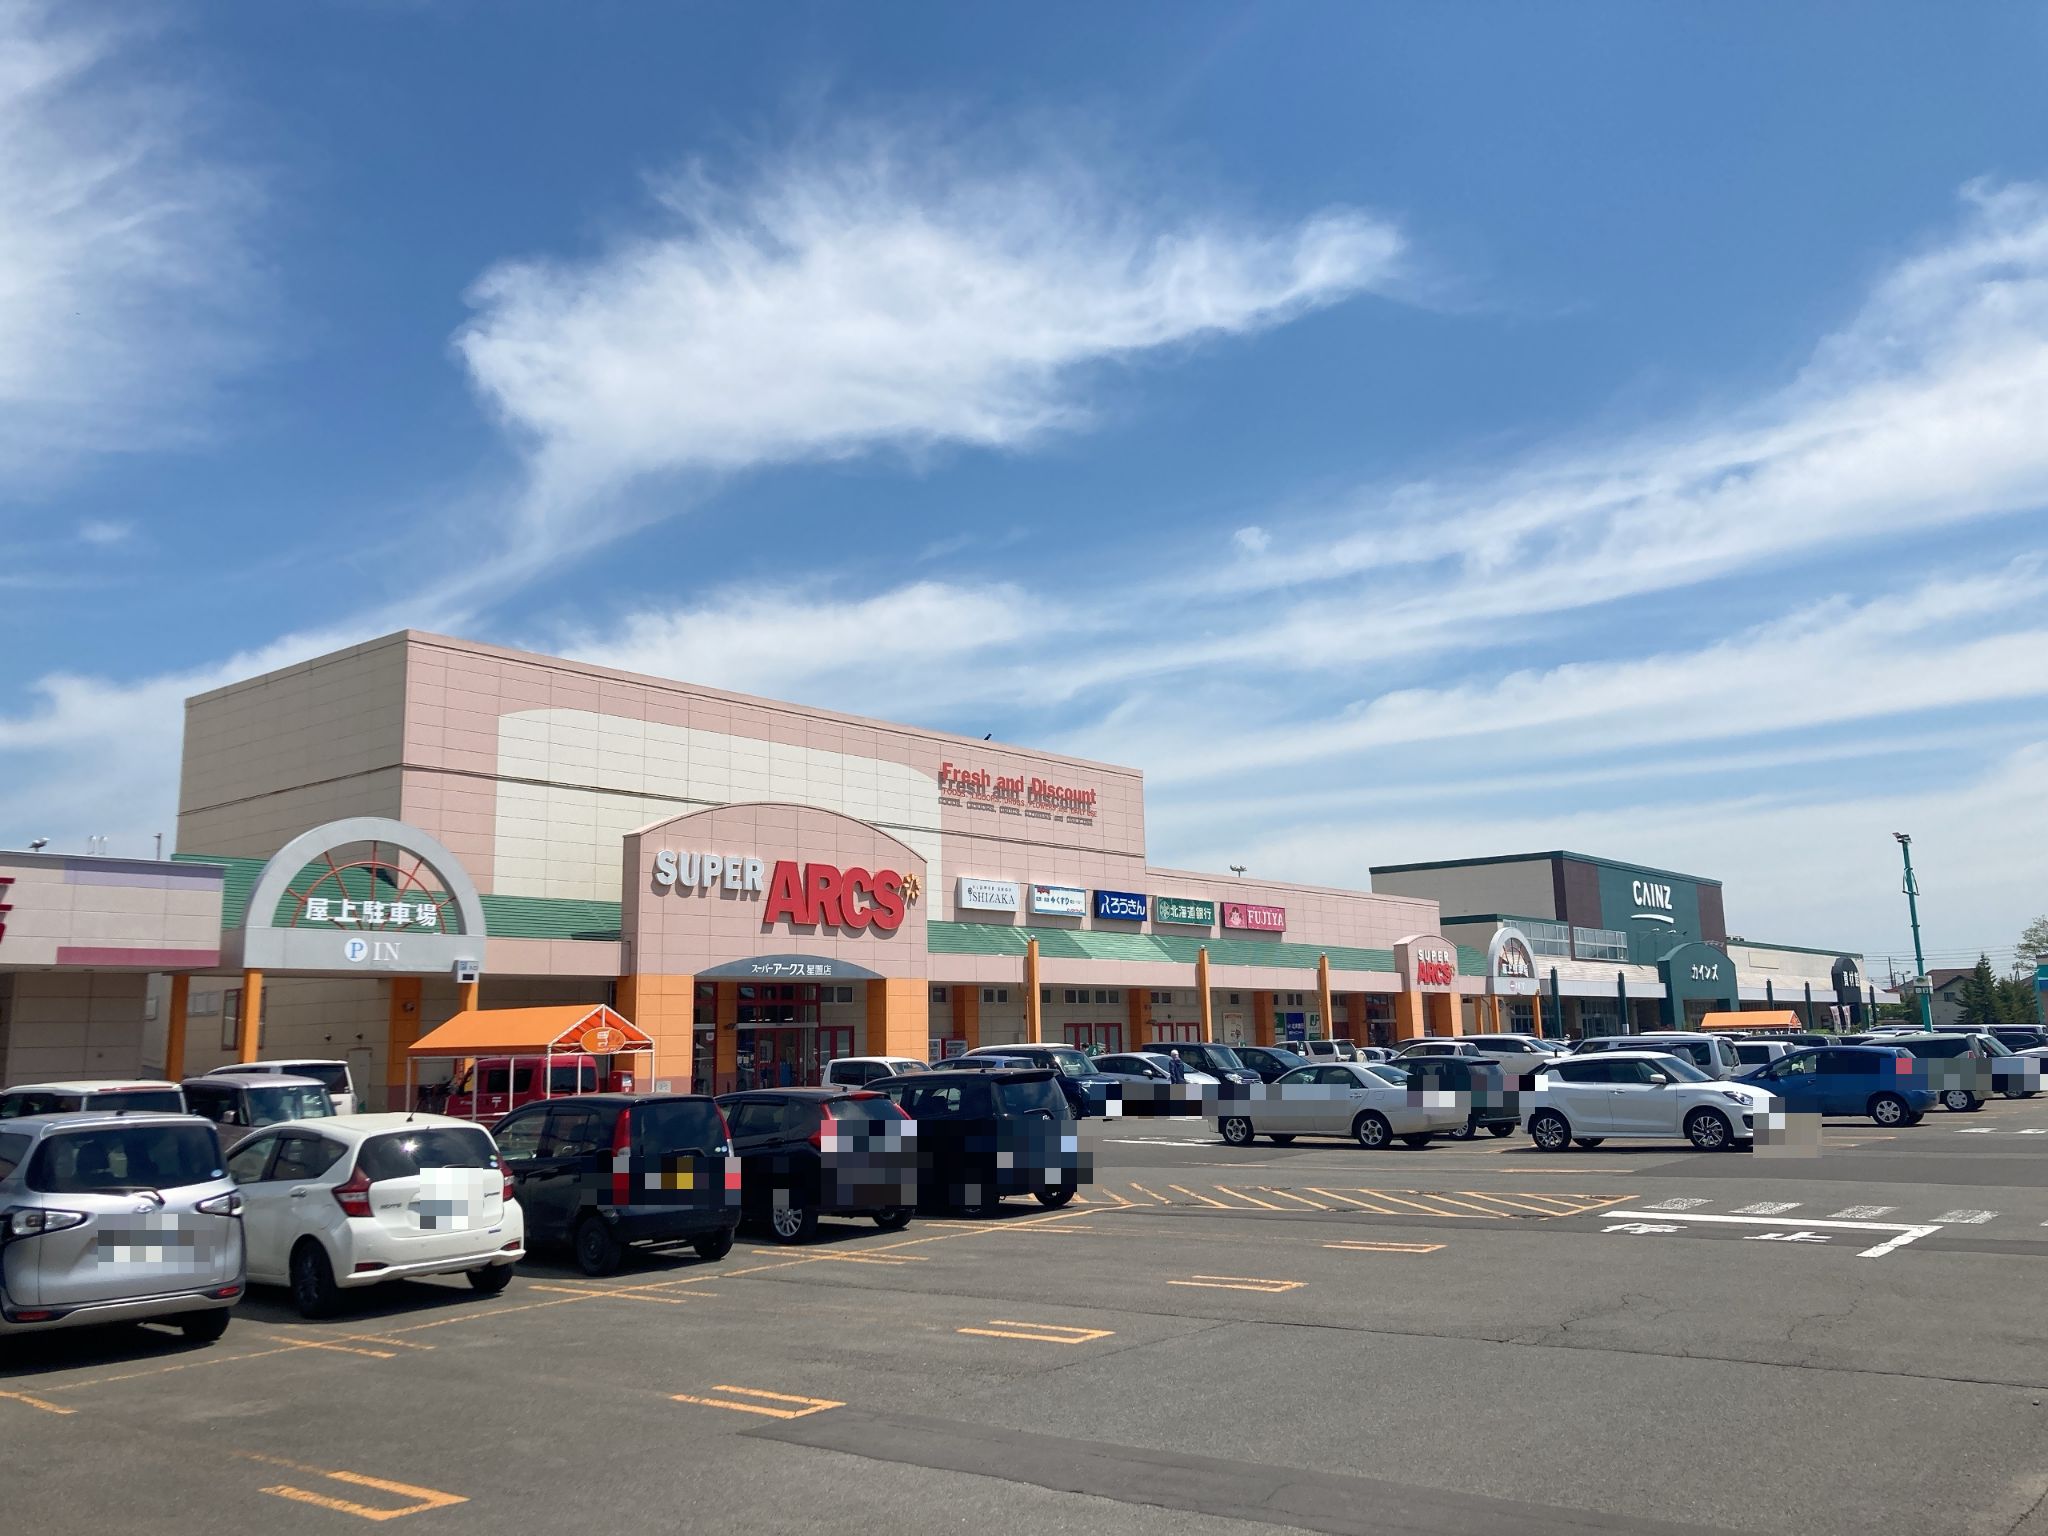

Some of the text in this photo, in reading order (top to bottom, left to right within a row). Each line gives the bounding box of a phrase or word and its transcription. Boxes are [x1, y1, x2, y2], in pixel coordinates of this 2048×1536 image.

[941, 761, 1097, 805] Fresh and Discount
[654, 849, 766, 892] SUPER
[764, 860, 906, 931] ARCS
[968, 889, 1015, 905] ISHIZAKA
[1632, 880, 1673, 910] CAINZ
[305, 897, 439, 927] 屋上駐車場
[1111, 897, 1146, 916] ろうきん
[1170, 904, 1212, 920] 北海道銀行
[1247, 908, 1285, 927] FUJIYA
[373, 942, 402, 961] IN
[1417, 949, 1449, 962] SUPER
[1417, 960, 1451, 986] ARCS
[1691, 963, 1719, 981] カインズ
